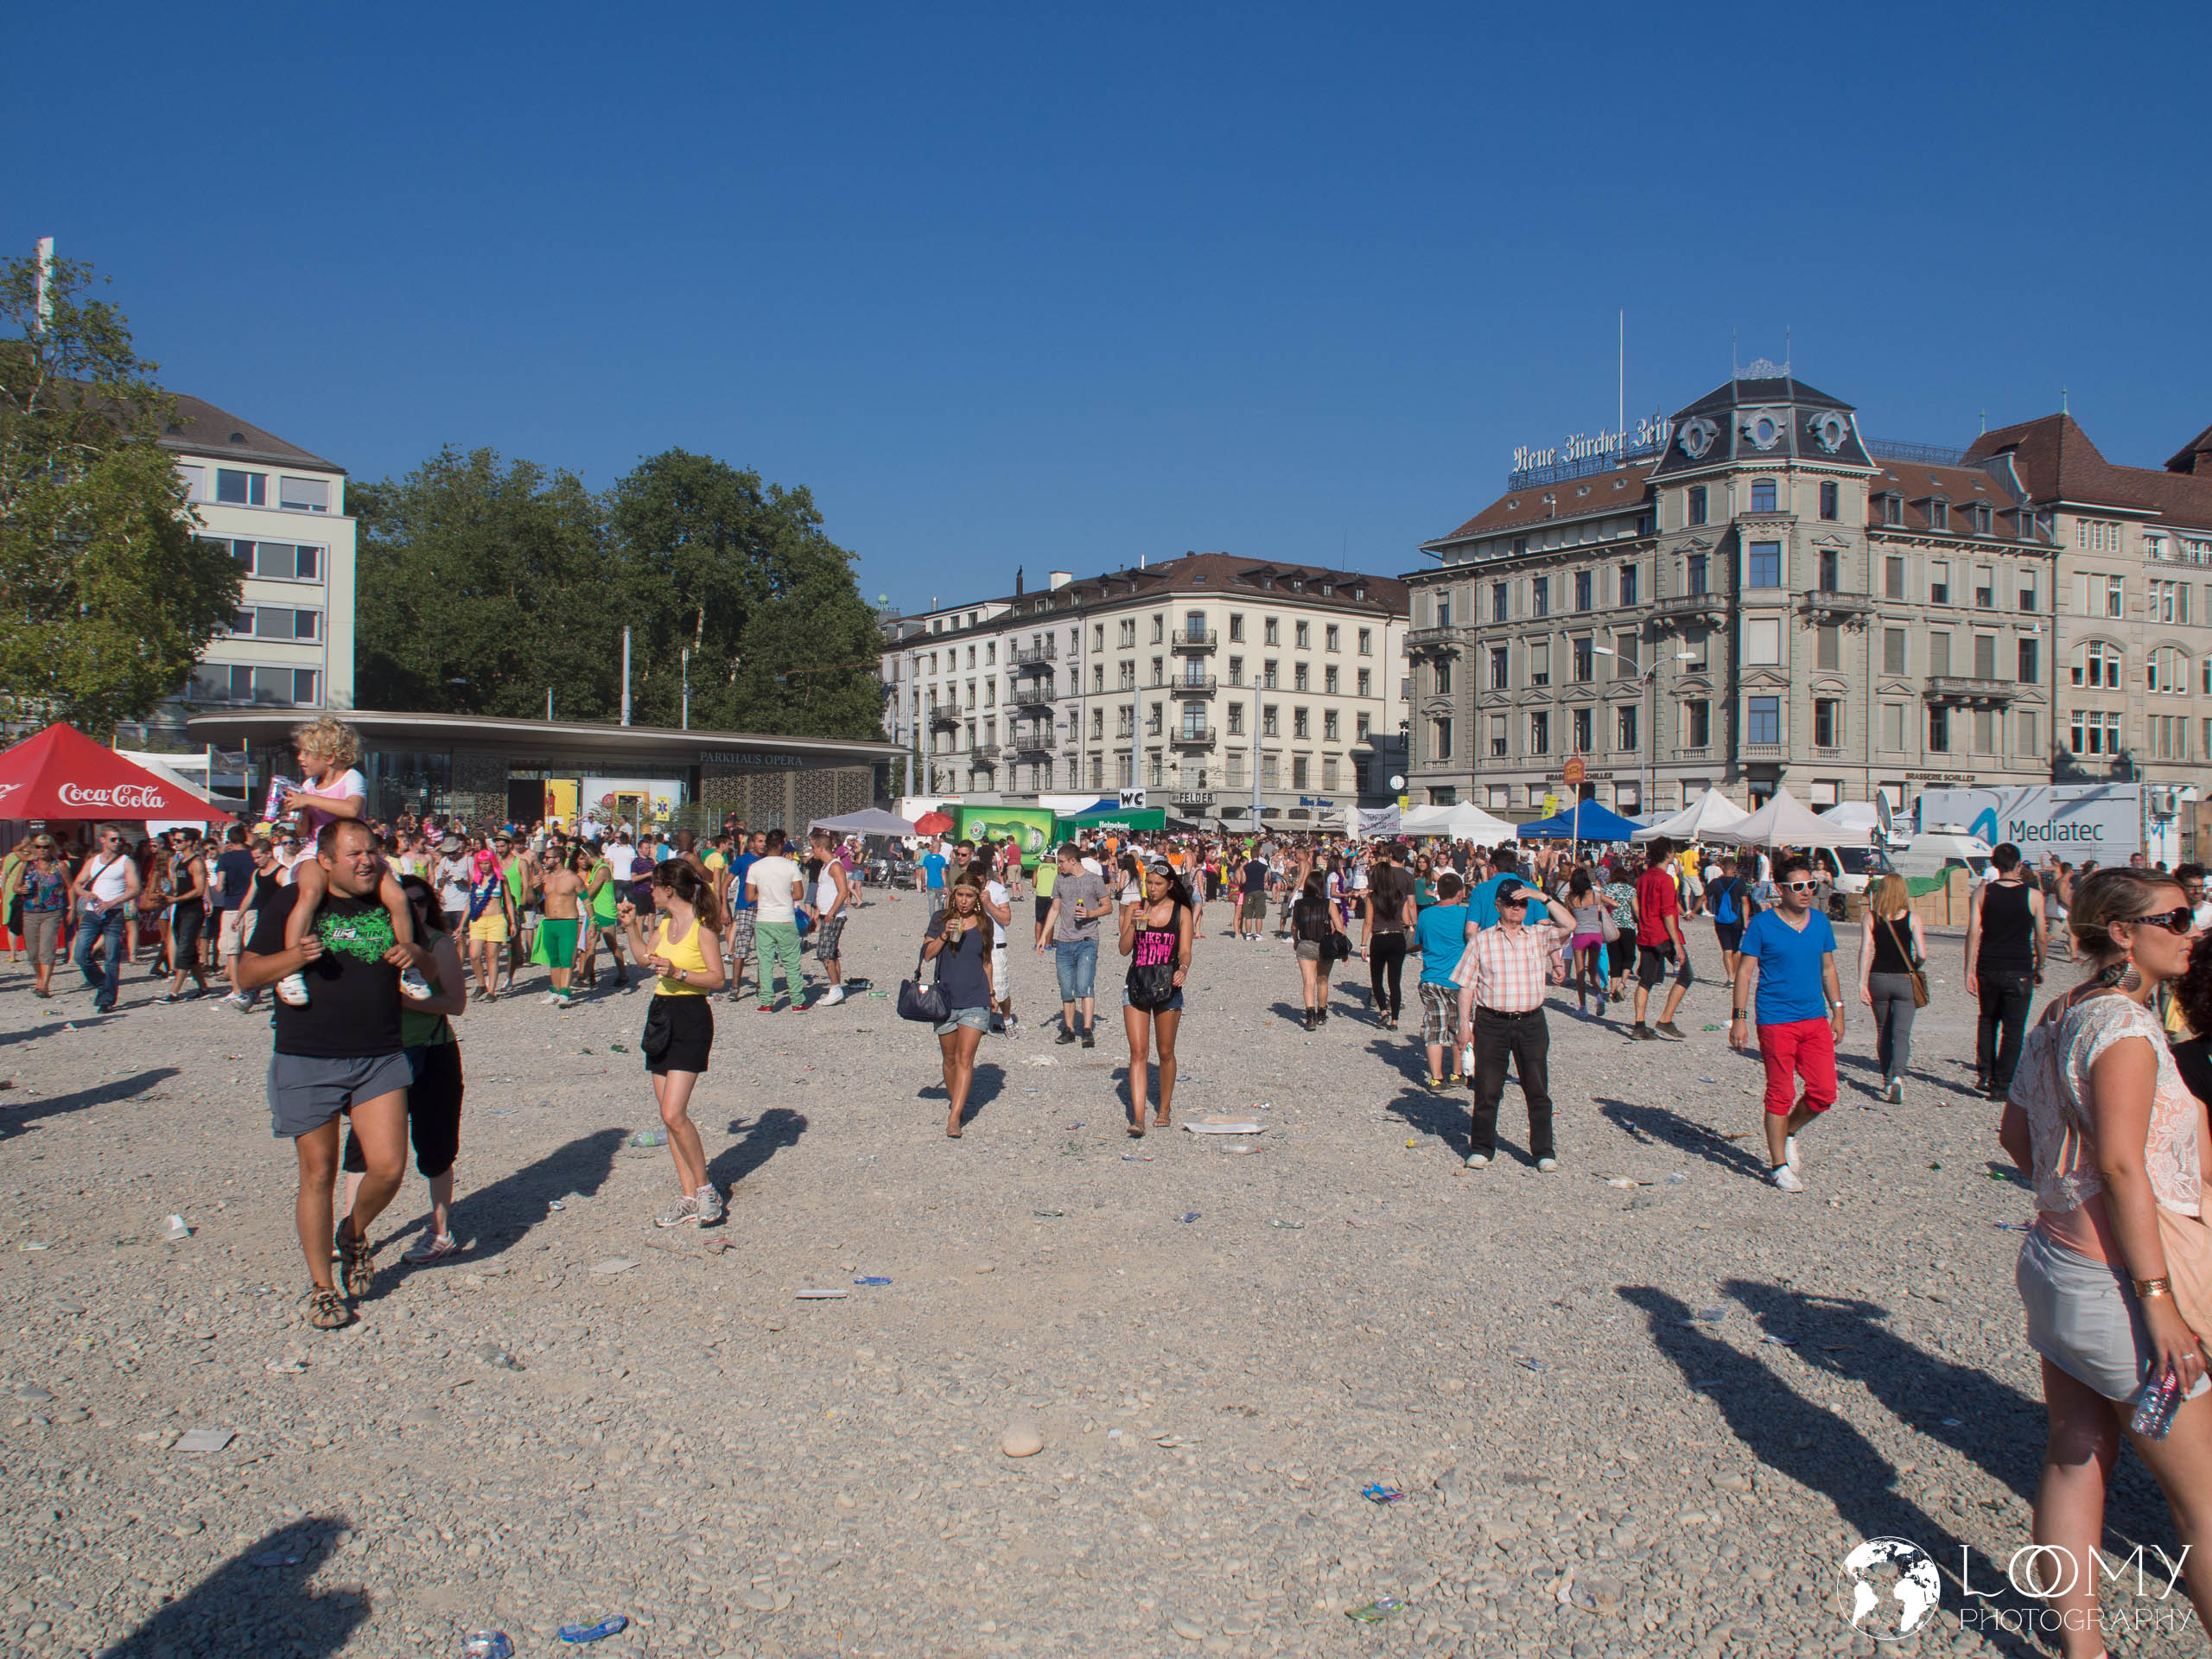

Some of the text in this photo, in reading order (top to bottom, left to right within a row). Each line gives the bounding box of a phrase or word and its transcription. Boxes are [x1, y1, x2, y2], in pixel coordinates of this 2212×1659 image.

[1513, 415, 1669, 474] Neue Zürcher Zeit
[700, 752, 761, 765] PARKHAUS
[1585, 772, 1613, 780] CHILLER
[1905, 772, 1976, 782] BRASSERIE SCHILLER
[58, 782, 165, 809] Coca-Cola
[1121, 792, 1143, 807] WC
[1179, 792, 1213, 803] FELDER
[2008, 819, 2104, 842] Mediatec
[1139, 931, 1162, 944] LIKE
[1163, 933, 1175, 945] TO
